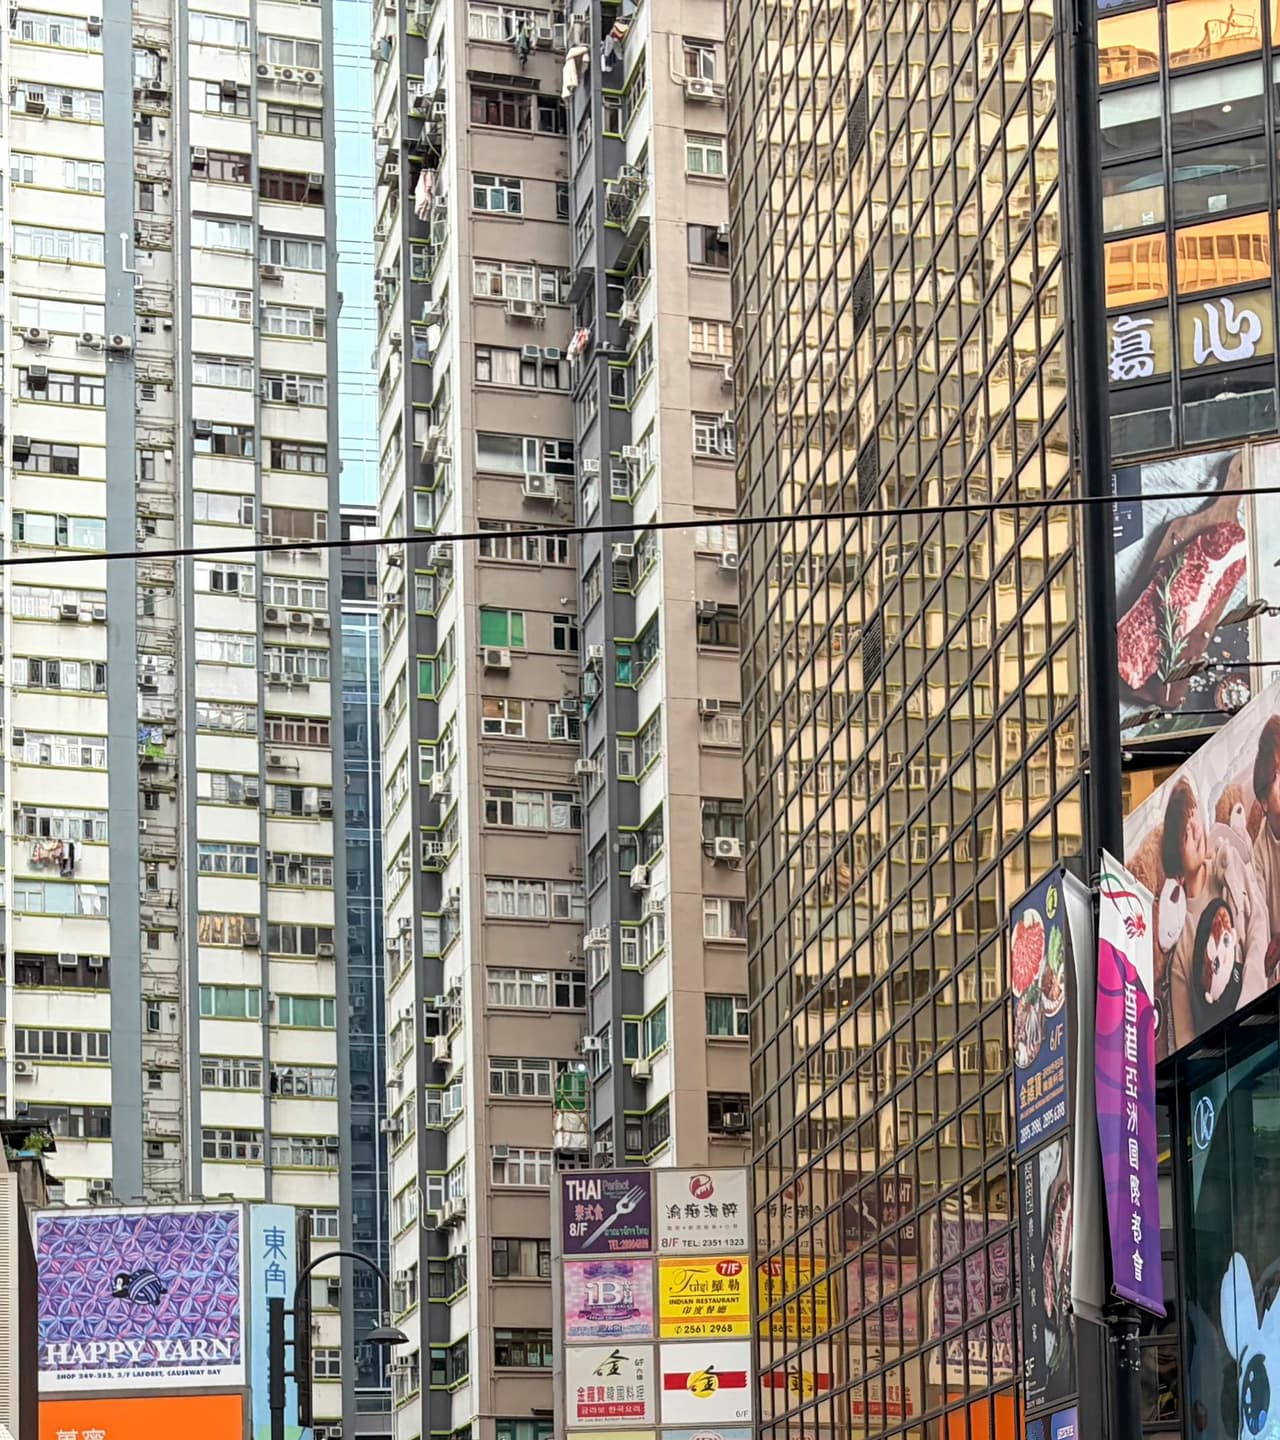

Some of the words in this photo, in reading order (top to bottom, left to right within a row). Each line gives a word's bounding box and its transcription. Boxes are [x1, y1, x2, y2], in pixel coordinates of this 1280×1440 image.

[1049, 1022, 1064, 1052] 6/F
[565, 1179, 602, 1201] THAI
[569, 1222, 588, 1237] 8/F
[661, 1238, 679, 1248] 8/F
[682, 1239, 700, 1248] TEL:
[702, 1238, 722, 1247] 2351
[725, 1238, 745, 1246] 1323
[261, 1224, 289, 1295] 東角
[720, 1262, 740, 1275] 7/F
[695, 1297, 740, 1305] RESTAURANT
[683, 1325, 706, 1334] 2561
[709, 1323, 733, 1333] 2968
[45, 1338, 147, 1365] HAPPY
[154, 1337, 236, 1362] YARN
[592, 1349, 630, 1377] 金
[167, 1369, 205, 1377] CAUSEWAY
[687, 1364, 721, 1393] 金
[735, 1410, 749, 1418] 6/F
